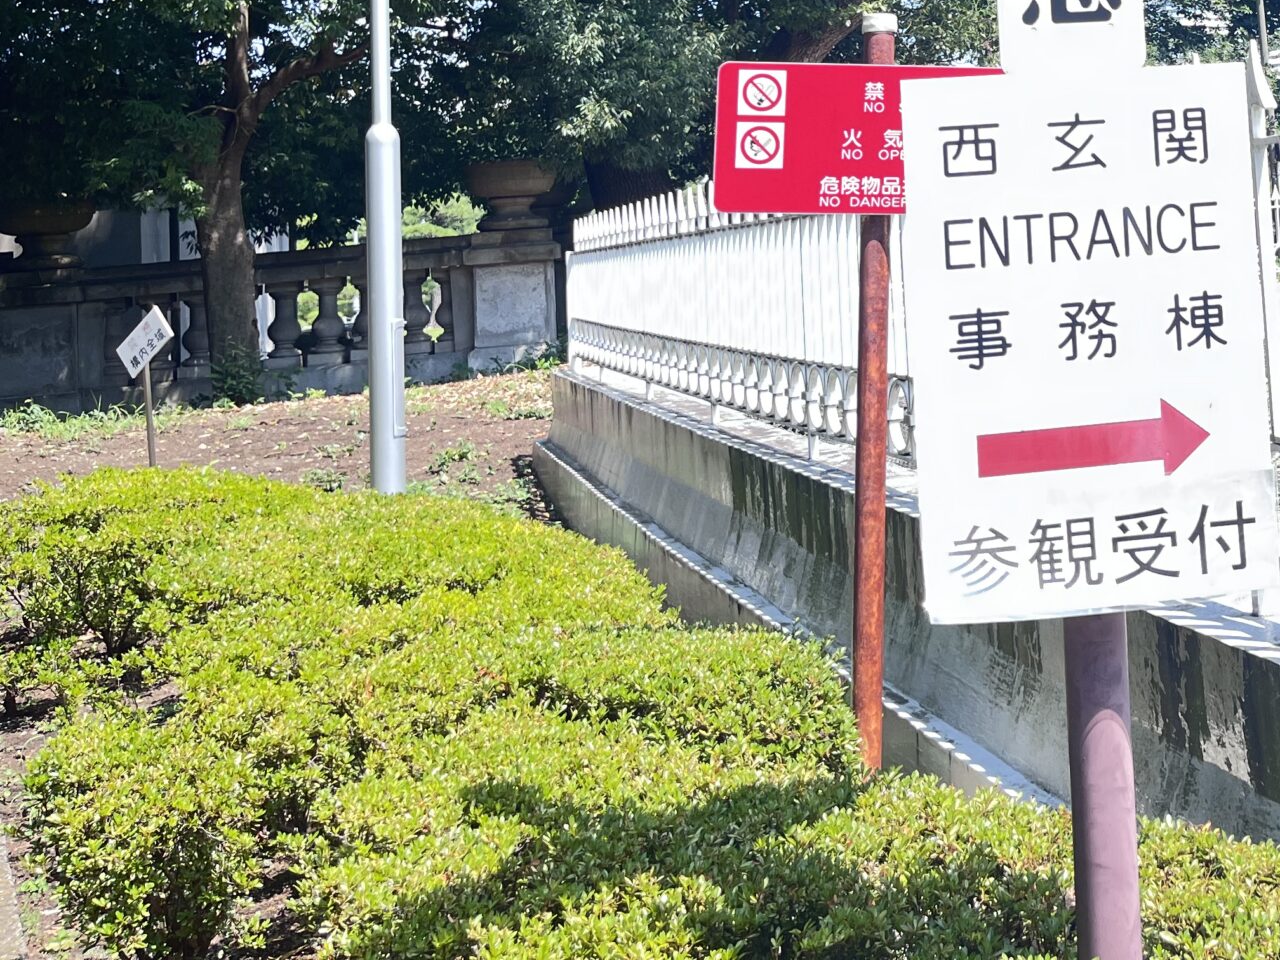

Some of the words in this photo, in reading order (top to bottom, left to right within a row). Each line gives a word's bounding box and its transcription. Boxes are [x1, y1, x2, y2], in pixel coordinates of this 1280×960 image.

[864, 81, 885, 101] 禁
[863, 102, 885, 113] NO
[842, 128, 903, 148] 火気
[938, 107, 1209, 177] 西玄関
[841, 149, 863, 160] NO
[819, 176, 906, 195] 危険物品
[819, 196, 841, 207] NO
[943, 201, 1220, 270] ENTRANCE
[949, 290, 1228, 371] 事務棟
[948, 500, 1256, 597] 参観受付
